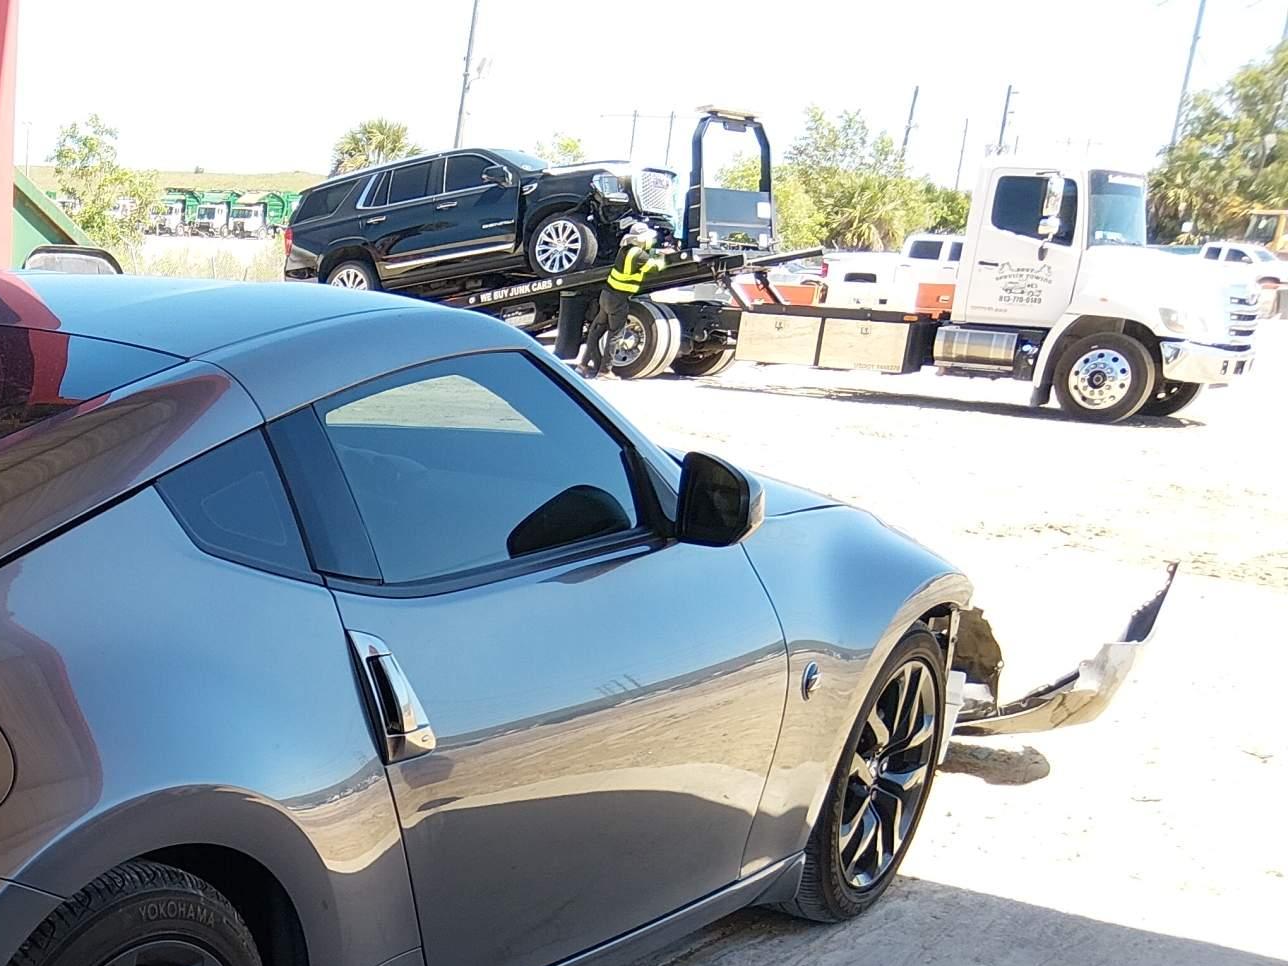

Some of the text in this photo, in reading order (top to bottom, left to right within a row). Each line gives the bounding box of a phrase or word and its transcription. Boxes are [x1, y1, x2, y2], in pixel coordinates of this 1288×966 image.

[480, 280, 552, 303] WE BUY JUNK CARS
[138, 901, 216, 929] YOKOHAMA
